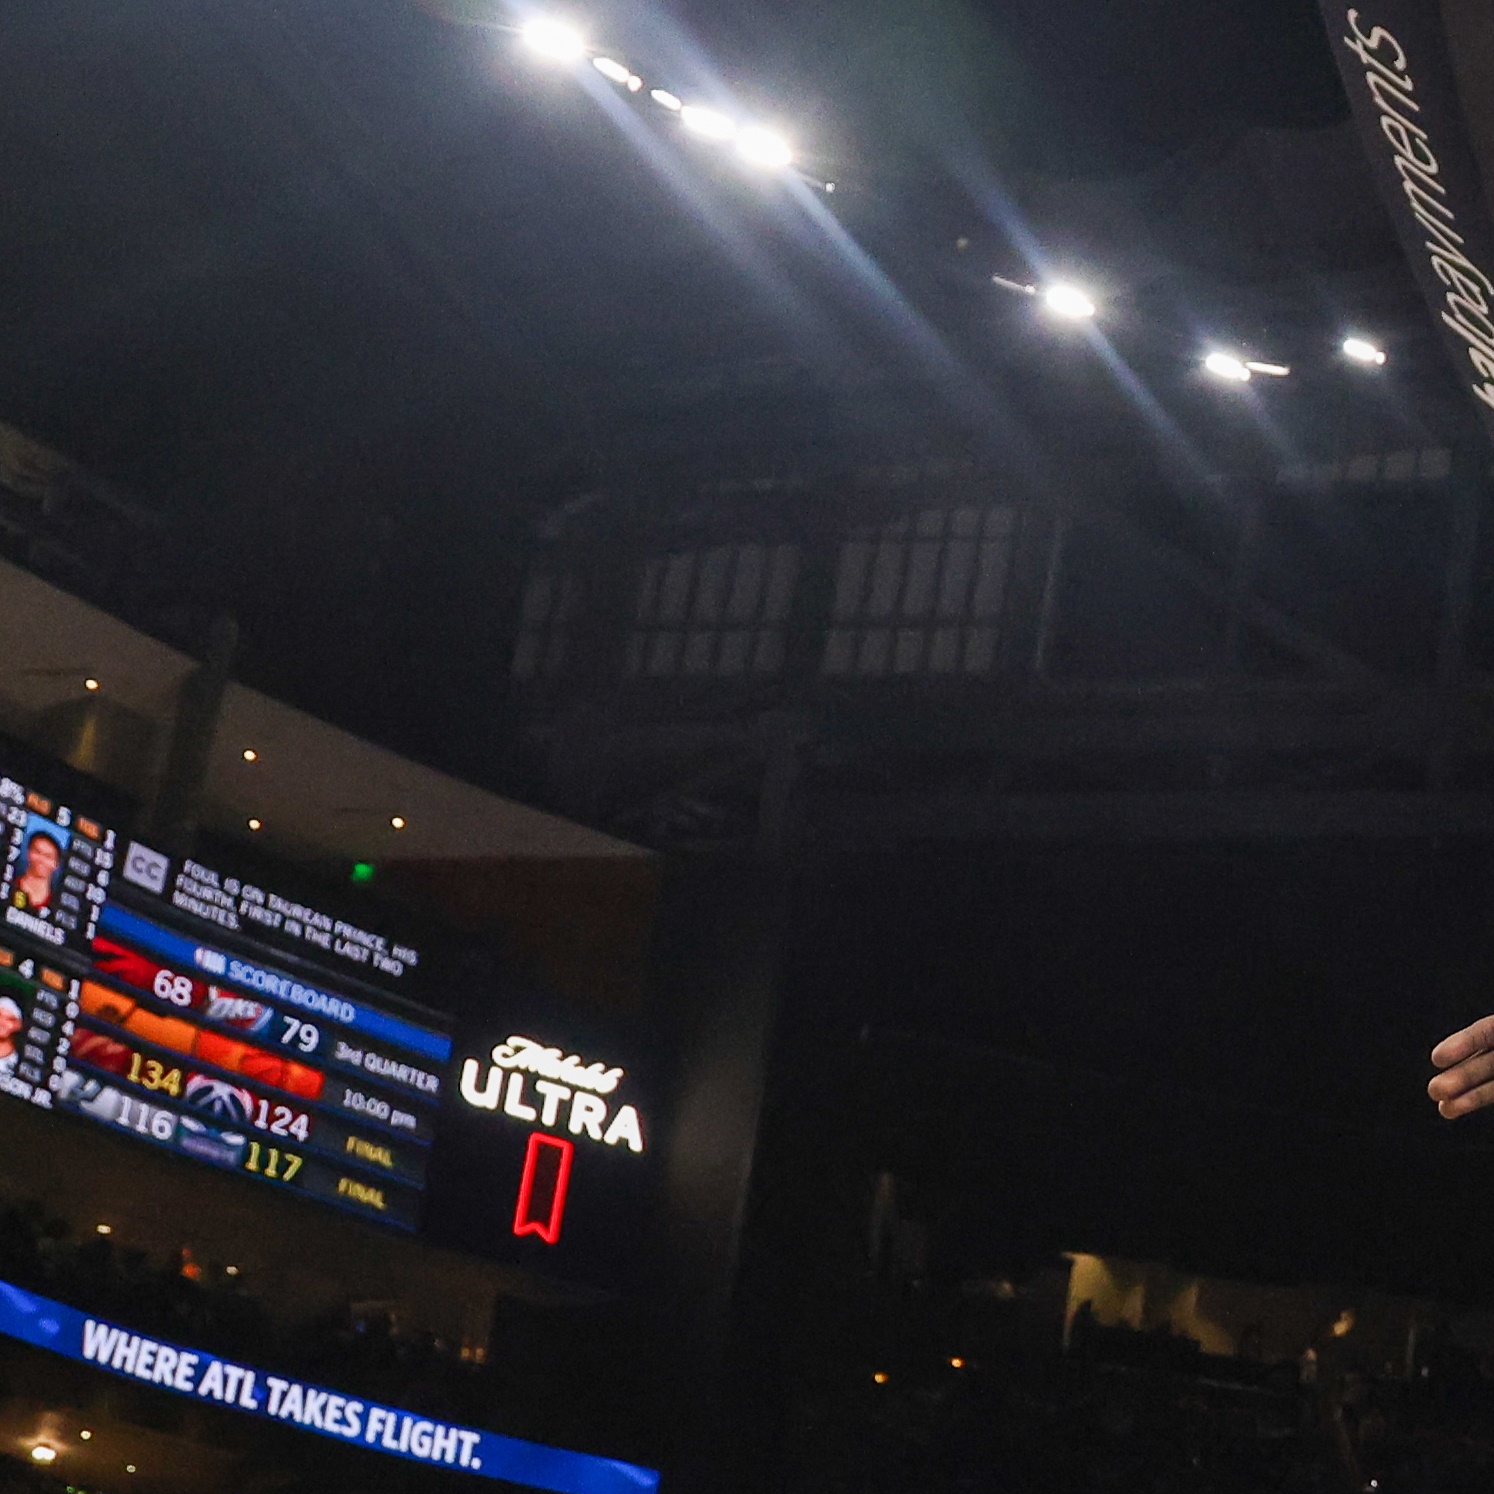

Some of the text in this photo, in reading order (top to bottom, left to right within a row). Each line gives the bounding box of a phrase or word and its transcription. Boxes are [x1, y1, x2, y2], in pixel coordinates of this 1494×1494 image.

[130, 853, 161, 882] CC
[153, 968, 194, 1007] 68
[280, 1015, 320, 1053] 79
[227, 960, 356, 1024] SCOREBOARD
[117, 1095, 303, 1182] 116 117
[125, 1052, 311, 1143] 134 124
[459, 1057, 644, 1153] ULTRA
[80, 1318, 483, 1470] WHERE ATL TAKES FLIGHT.
